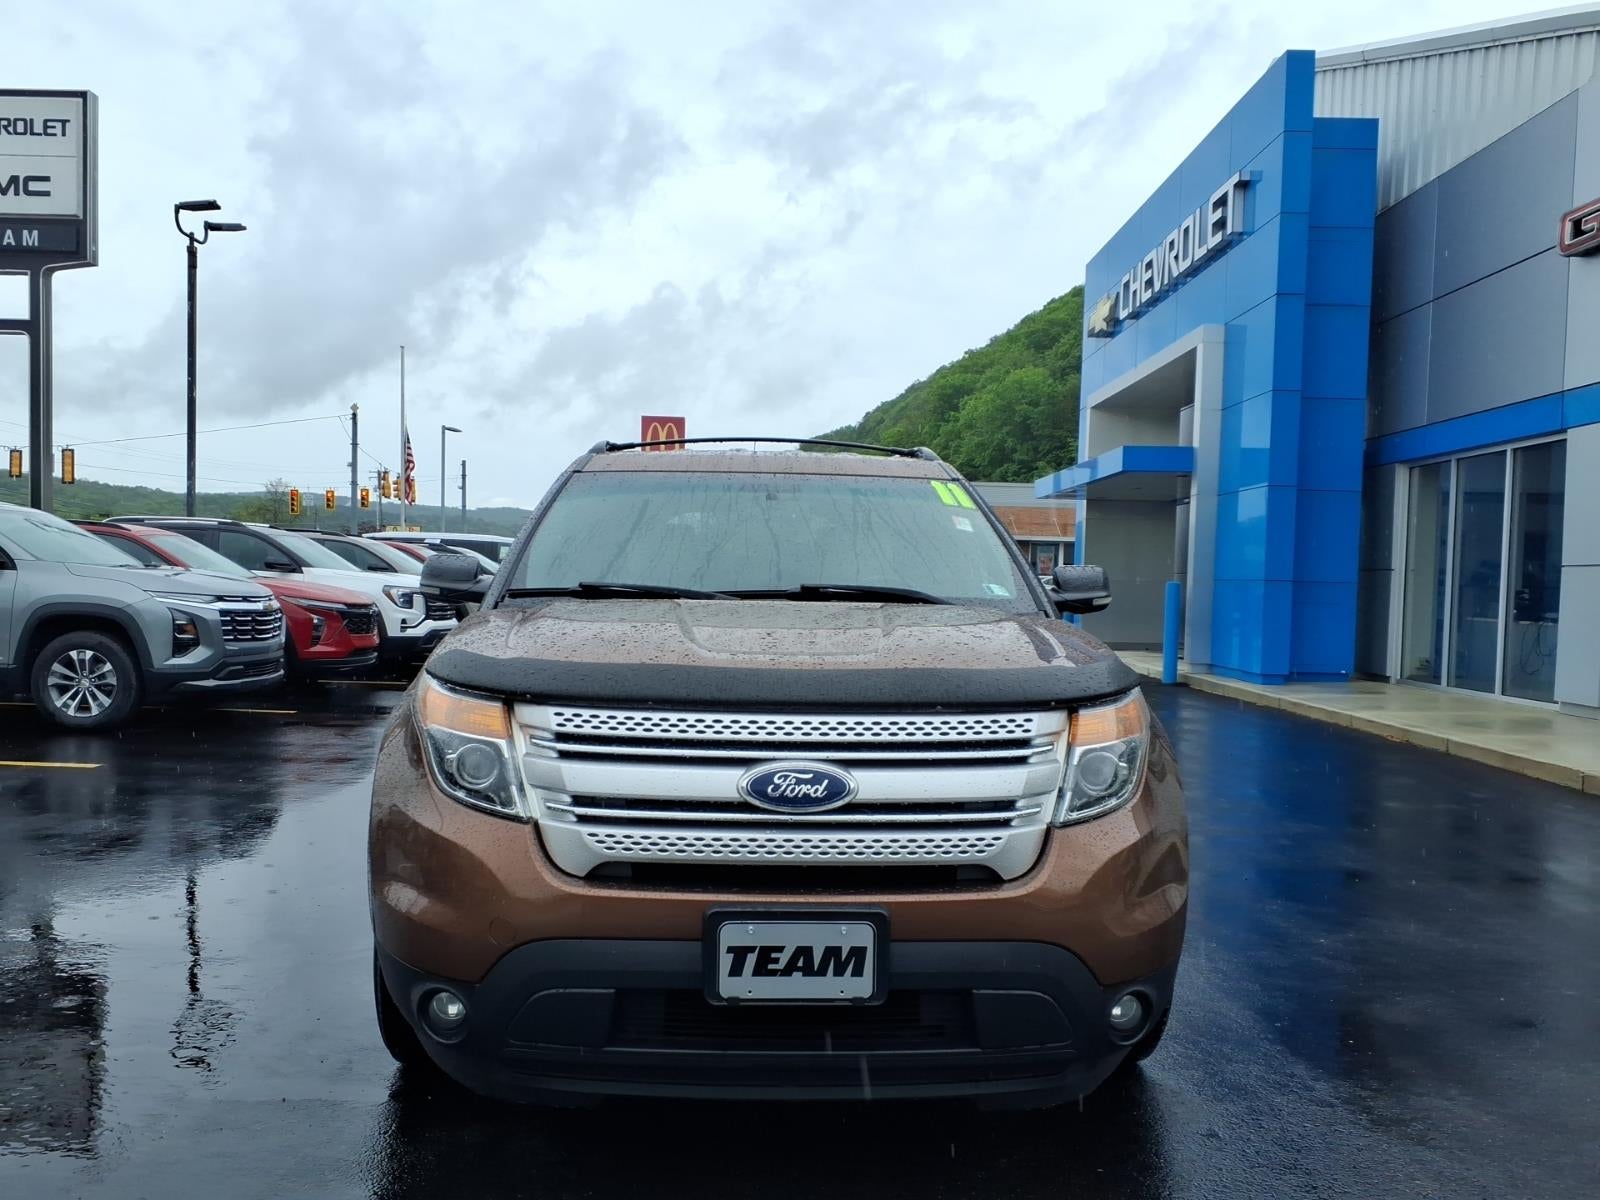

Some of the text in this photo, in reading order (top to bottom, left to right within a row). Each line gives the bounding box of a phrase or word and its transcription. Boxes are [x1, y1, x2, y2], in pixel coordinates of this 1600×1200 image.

[1118, 170, 1246, 321] CHEVROLET
[767, 771, 829, 798] Ford
[726, 945, 868, 978] TEAM
